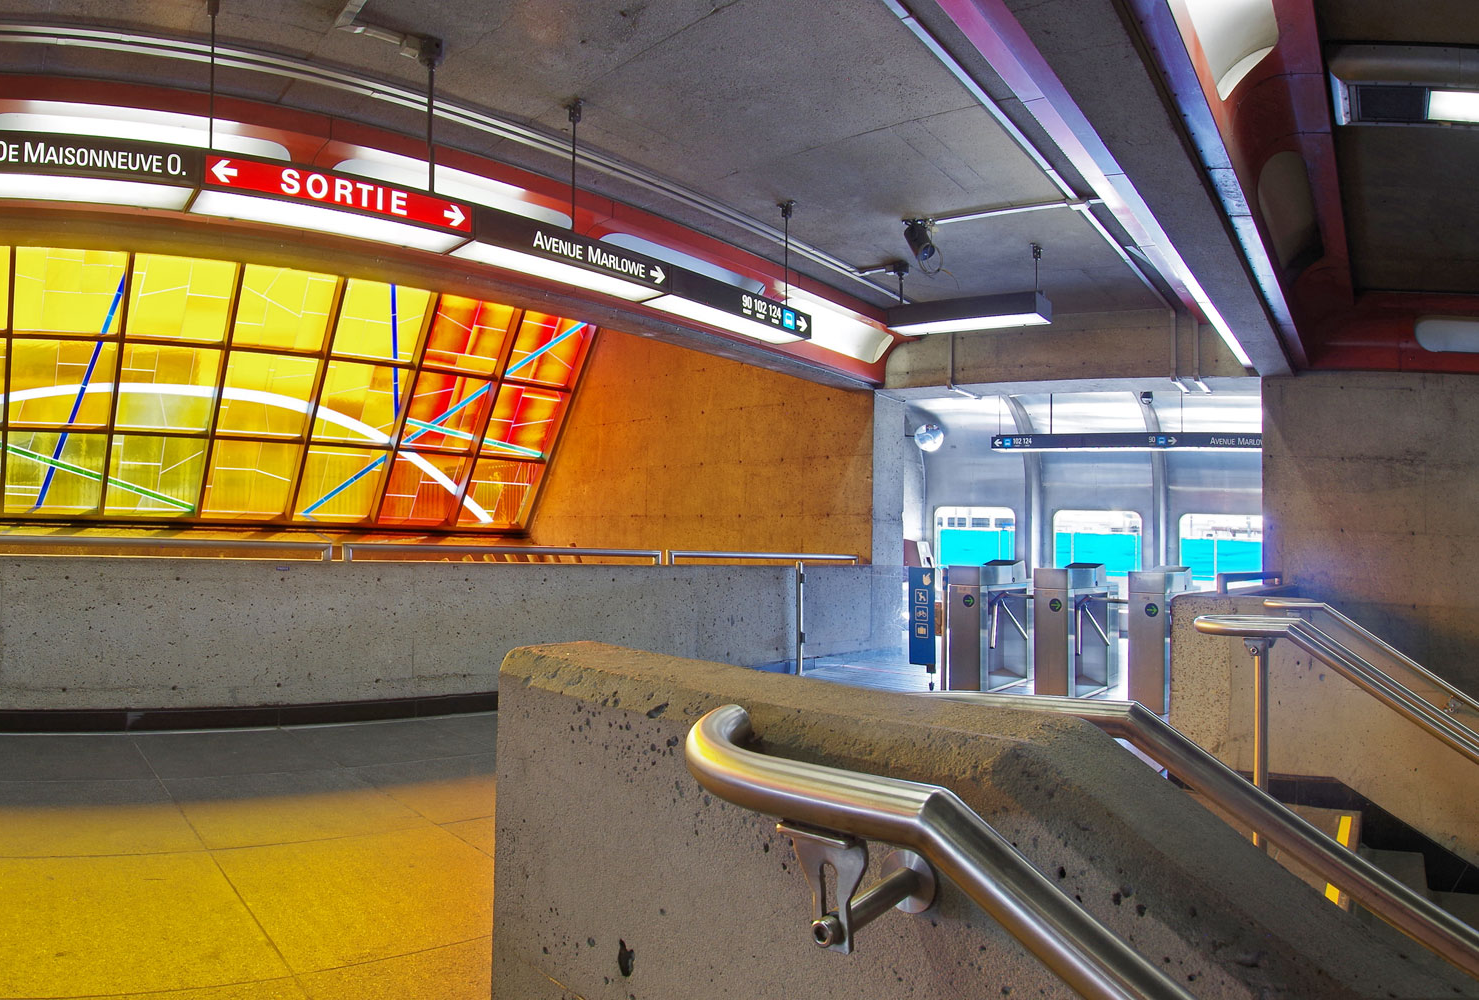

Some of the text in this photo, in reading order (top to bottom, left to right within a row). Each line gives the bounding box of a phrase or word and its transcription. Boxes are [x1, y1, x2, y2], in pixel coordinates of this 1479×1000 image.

[23, 141, 162, 173] MAISONNEUVE
[167, 153, 187, 176] O.
[280, 168, 408, 216] SORTIE
[532, 230, 646, 278] AVENUE MARLOWE
[741, 294, 753, 309] 90
[754, 298, 768, 315] 102
[768, 304, 782, 320] 124
[1013, 437, 1032, 445] 102 124
[1148, 435, 1156, 443] 90
[1209, 436, 1235, 446] AVENUE
